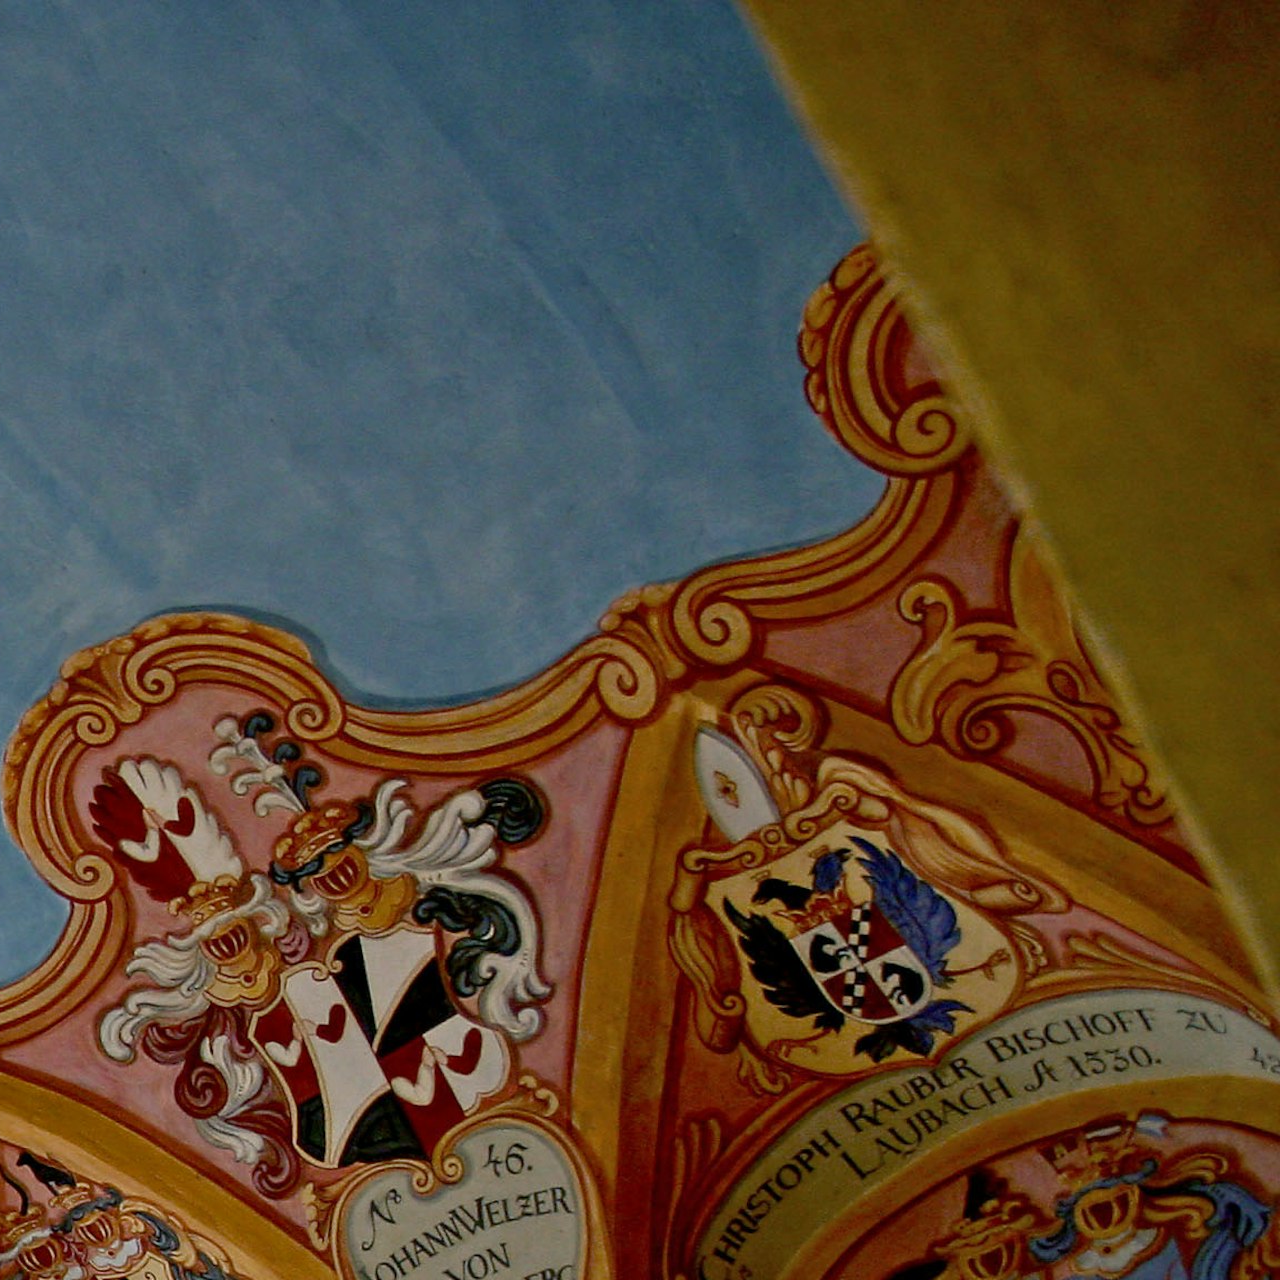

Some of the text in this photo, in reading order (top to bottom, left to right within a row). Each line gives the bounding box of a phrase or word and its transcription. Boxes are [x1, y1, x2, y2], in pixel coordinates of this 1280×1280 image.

[840, 1057, 984, 1133] RAUBER
[985, 1008, 1155, 1064] BISCHOFF
[1177, 1009, 1227, 1034] ZU
[841, 1076, 1014, 1180] LAUBACH
[458, 1186, 574, 1235] WELZER
